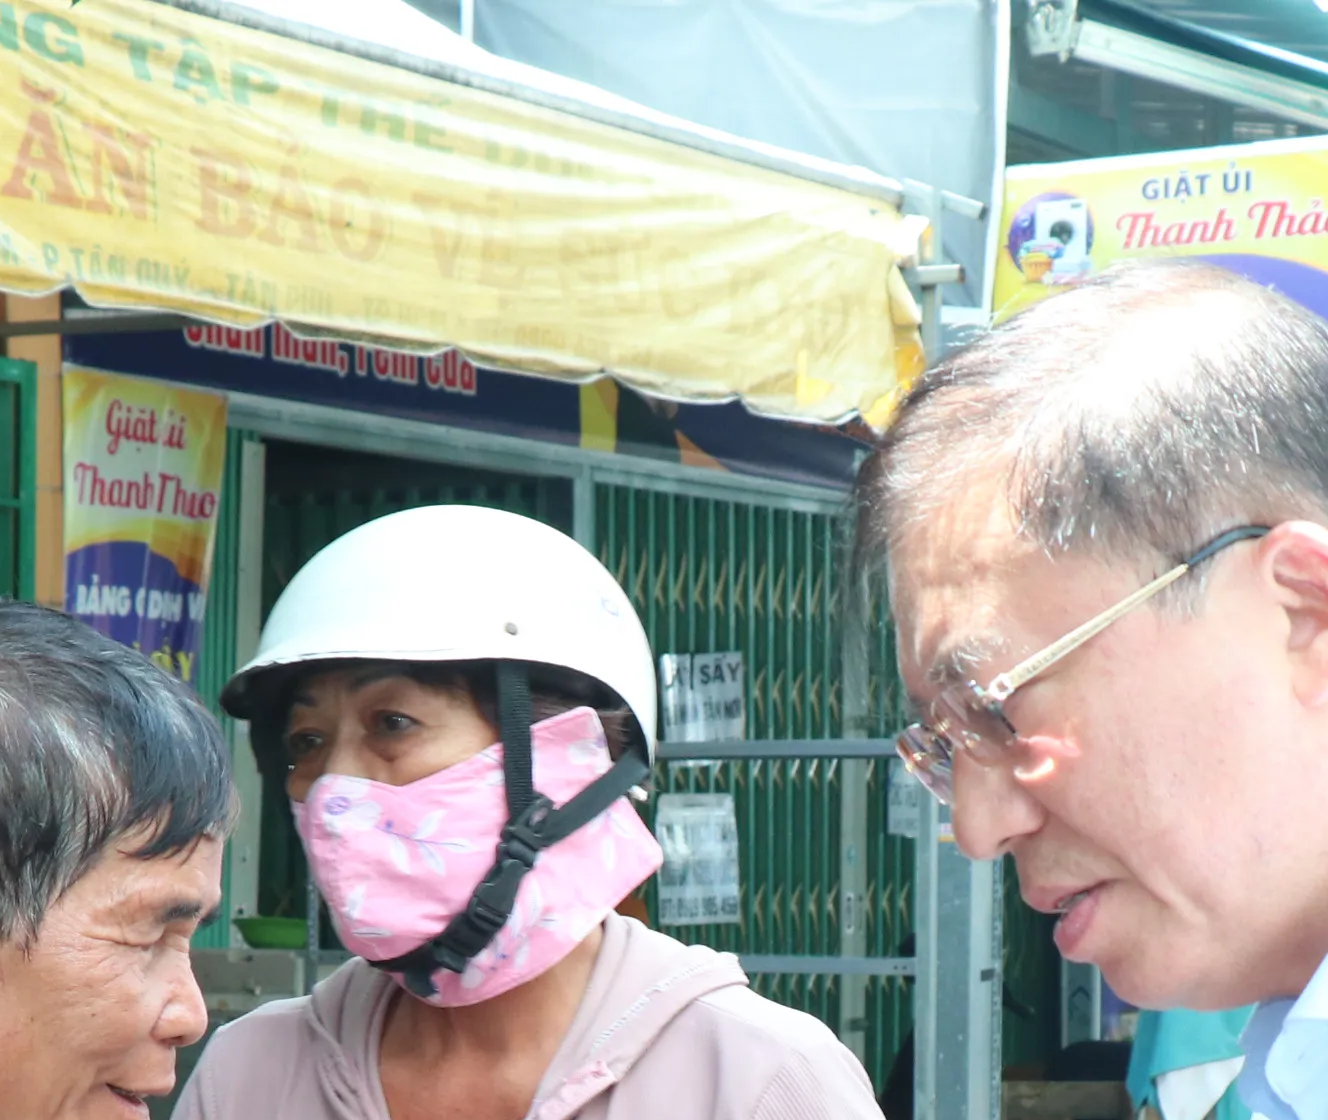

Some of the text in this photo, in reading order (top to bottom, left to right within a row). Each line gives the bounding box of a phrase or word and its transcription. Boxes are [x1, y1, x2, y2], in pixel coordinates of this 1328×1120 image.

[0, 76, 156, 222] ĂN
[1142, 161, 1252, 203] GIẶT ỦI
[1116, 207, 1237, 250] Thanh
[74, 461, 155, 510] Thanh
